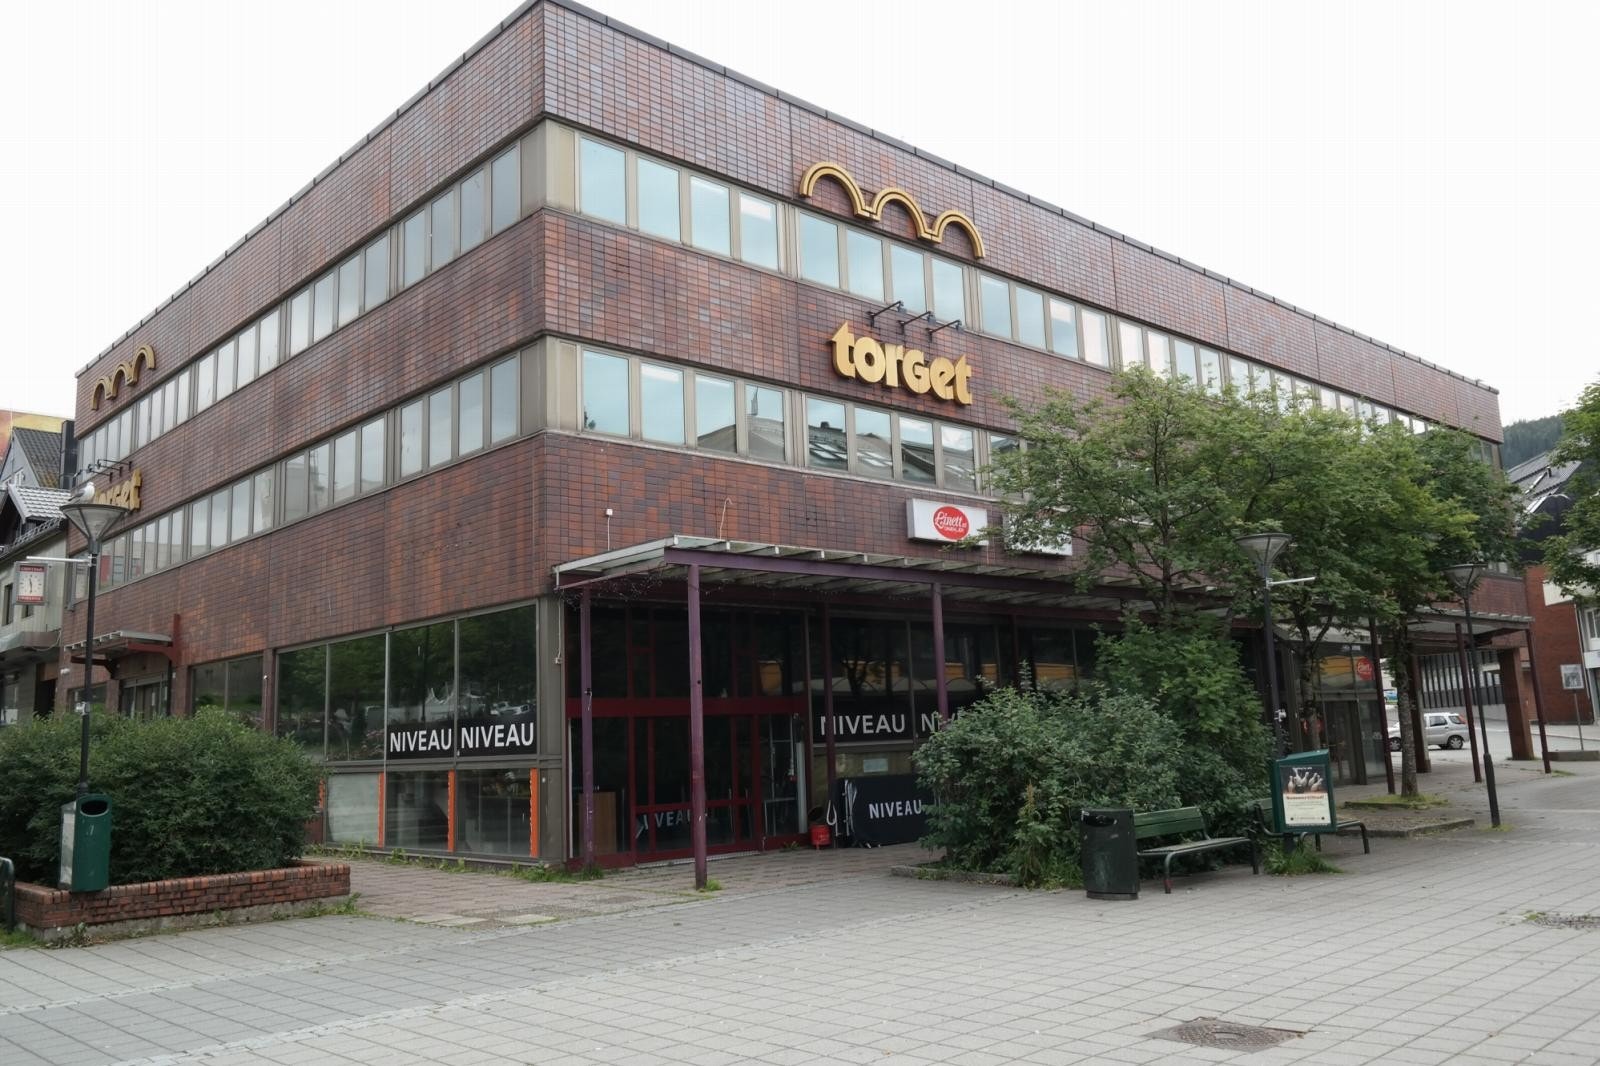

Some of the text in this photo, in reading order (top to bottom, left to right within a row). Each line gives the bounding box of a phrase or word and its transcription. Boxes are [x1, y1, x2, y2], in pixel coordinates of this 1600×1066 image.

[390, 728, 452, 752] NIVEAU
[461, 722, 534, 749] NIVEAU
[868, 799, 922, 819] NIVEAU
